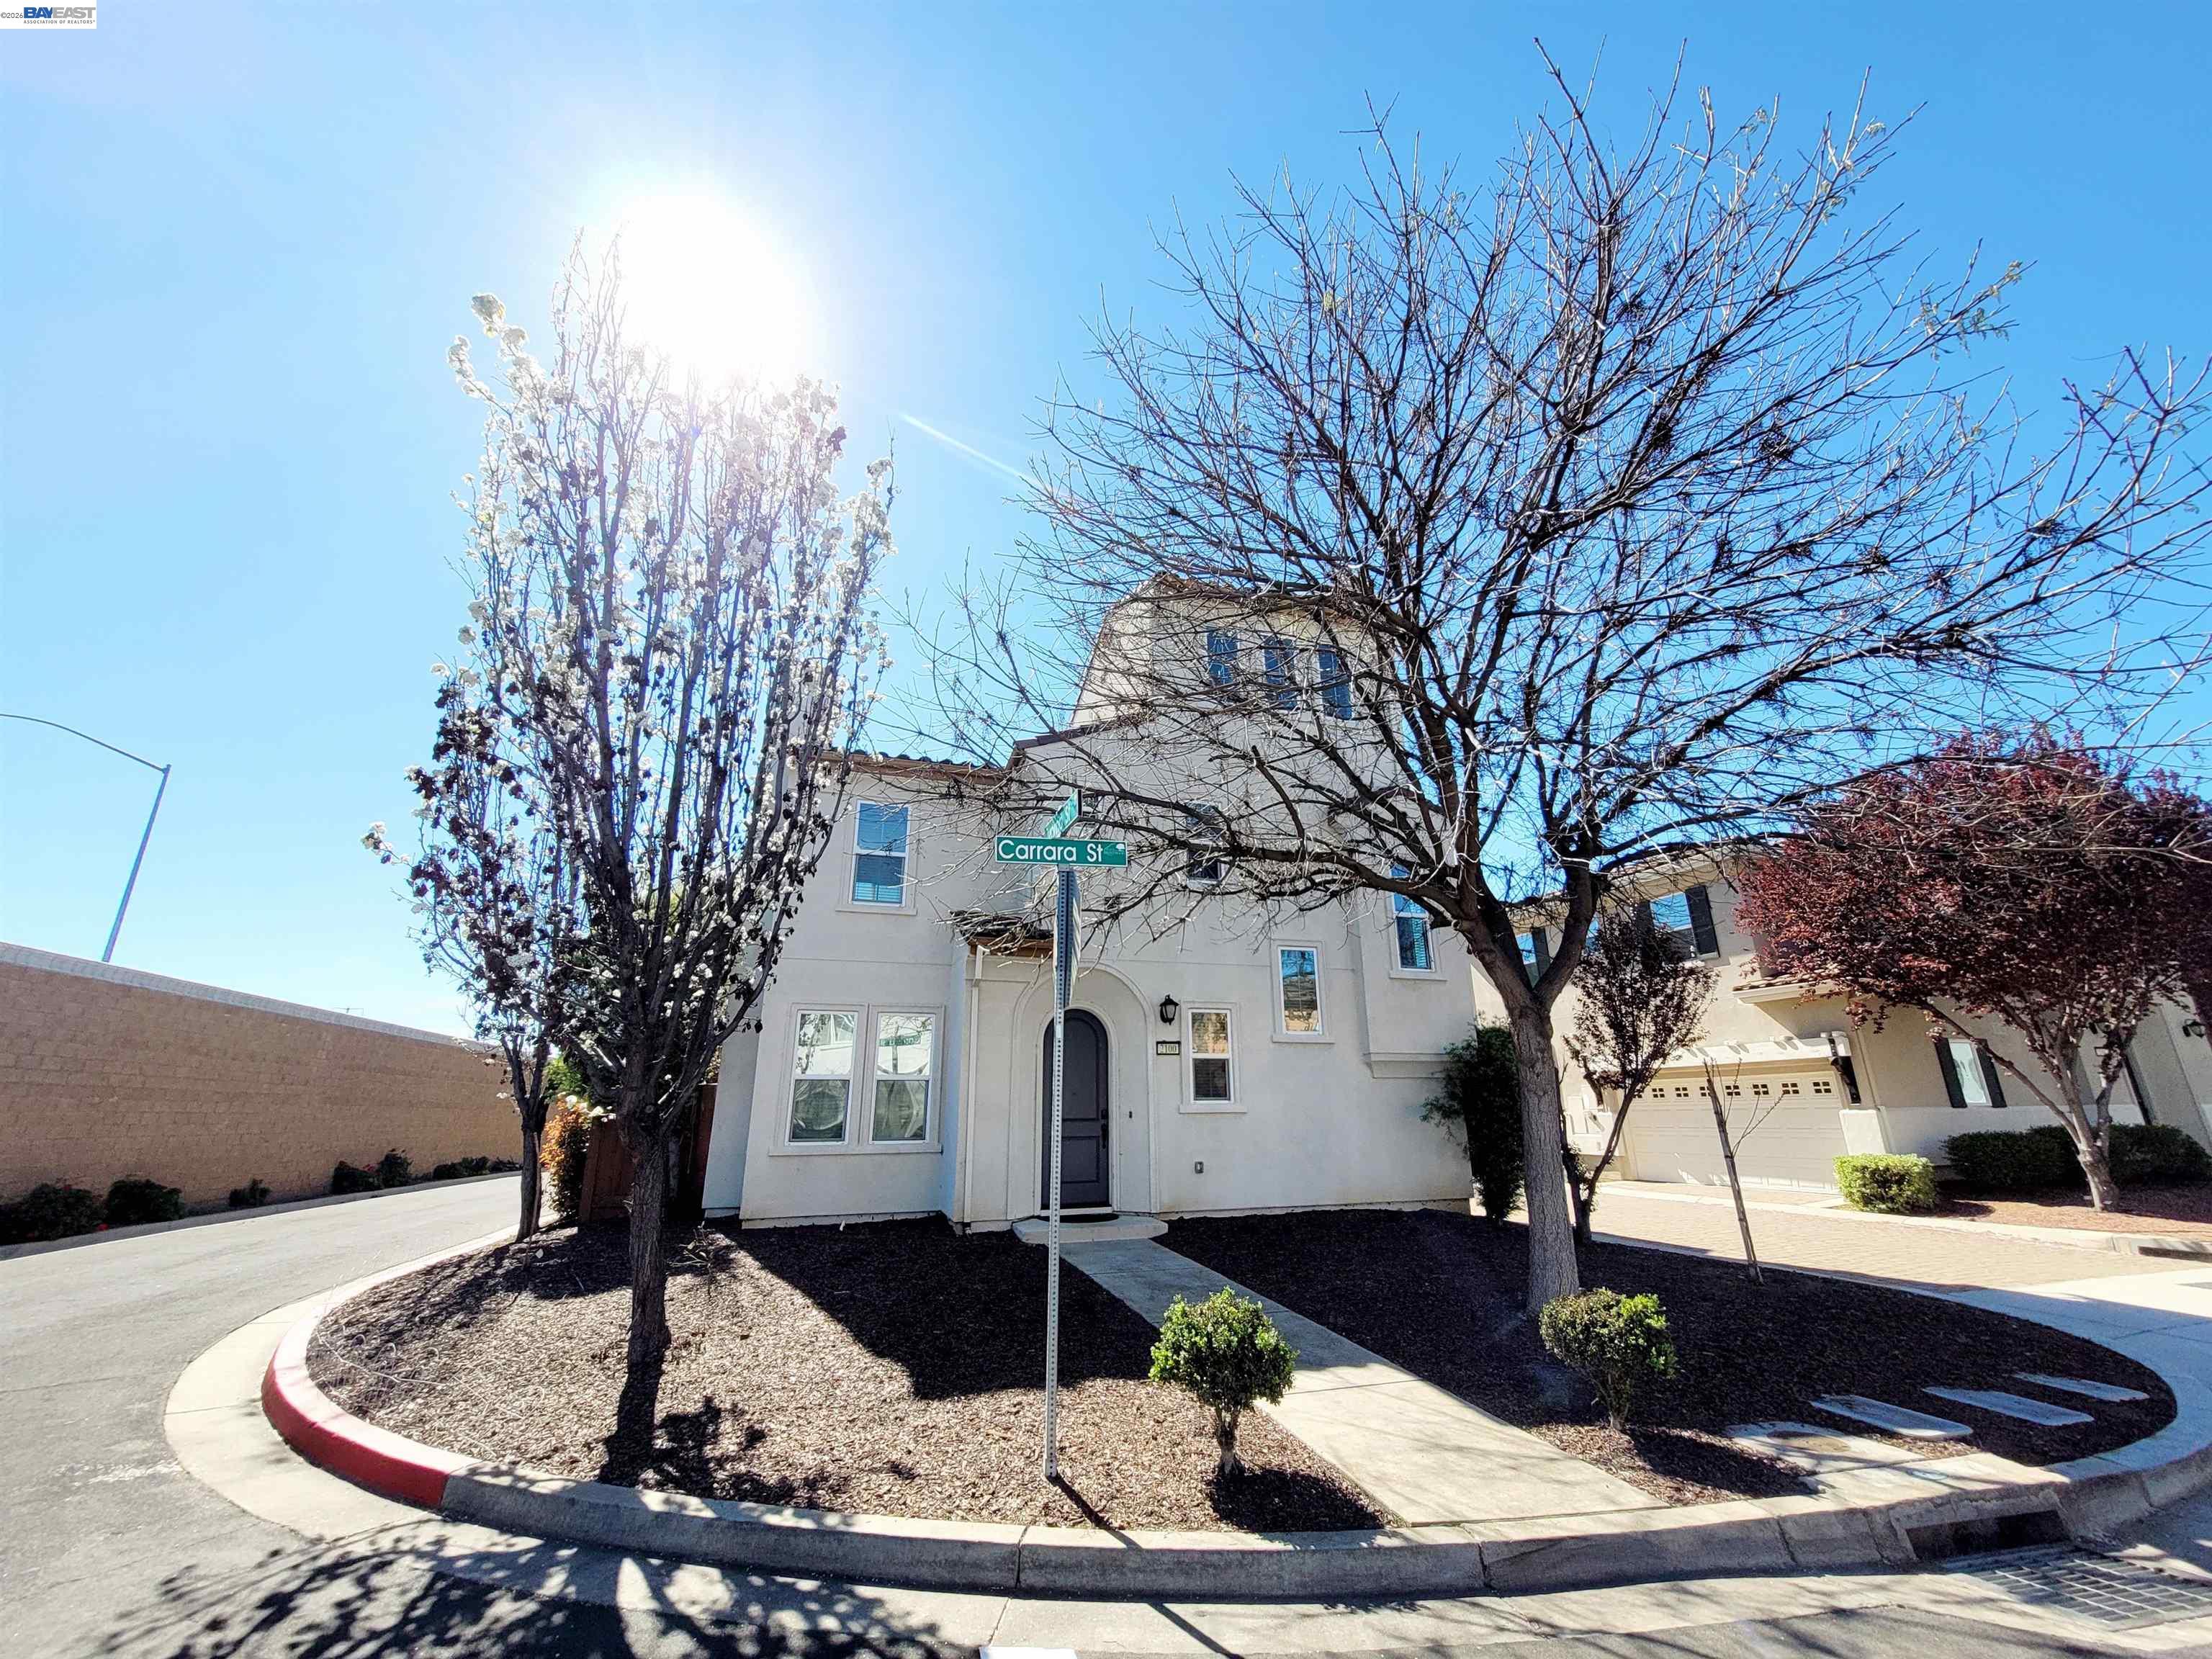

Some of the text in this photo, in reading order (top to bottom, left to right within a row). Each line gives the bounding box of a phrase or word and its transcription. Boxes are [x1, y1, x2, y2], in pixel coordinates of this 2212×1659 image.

[998, 840, 1103, 862] Carrara St
[1159, 1044, 1177, 1053] 2100
